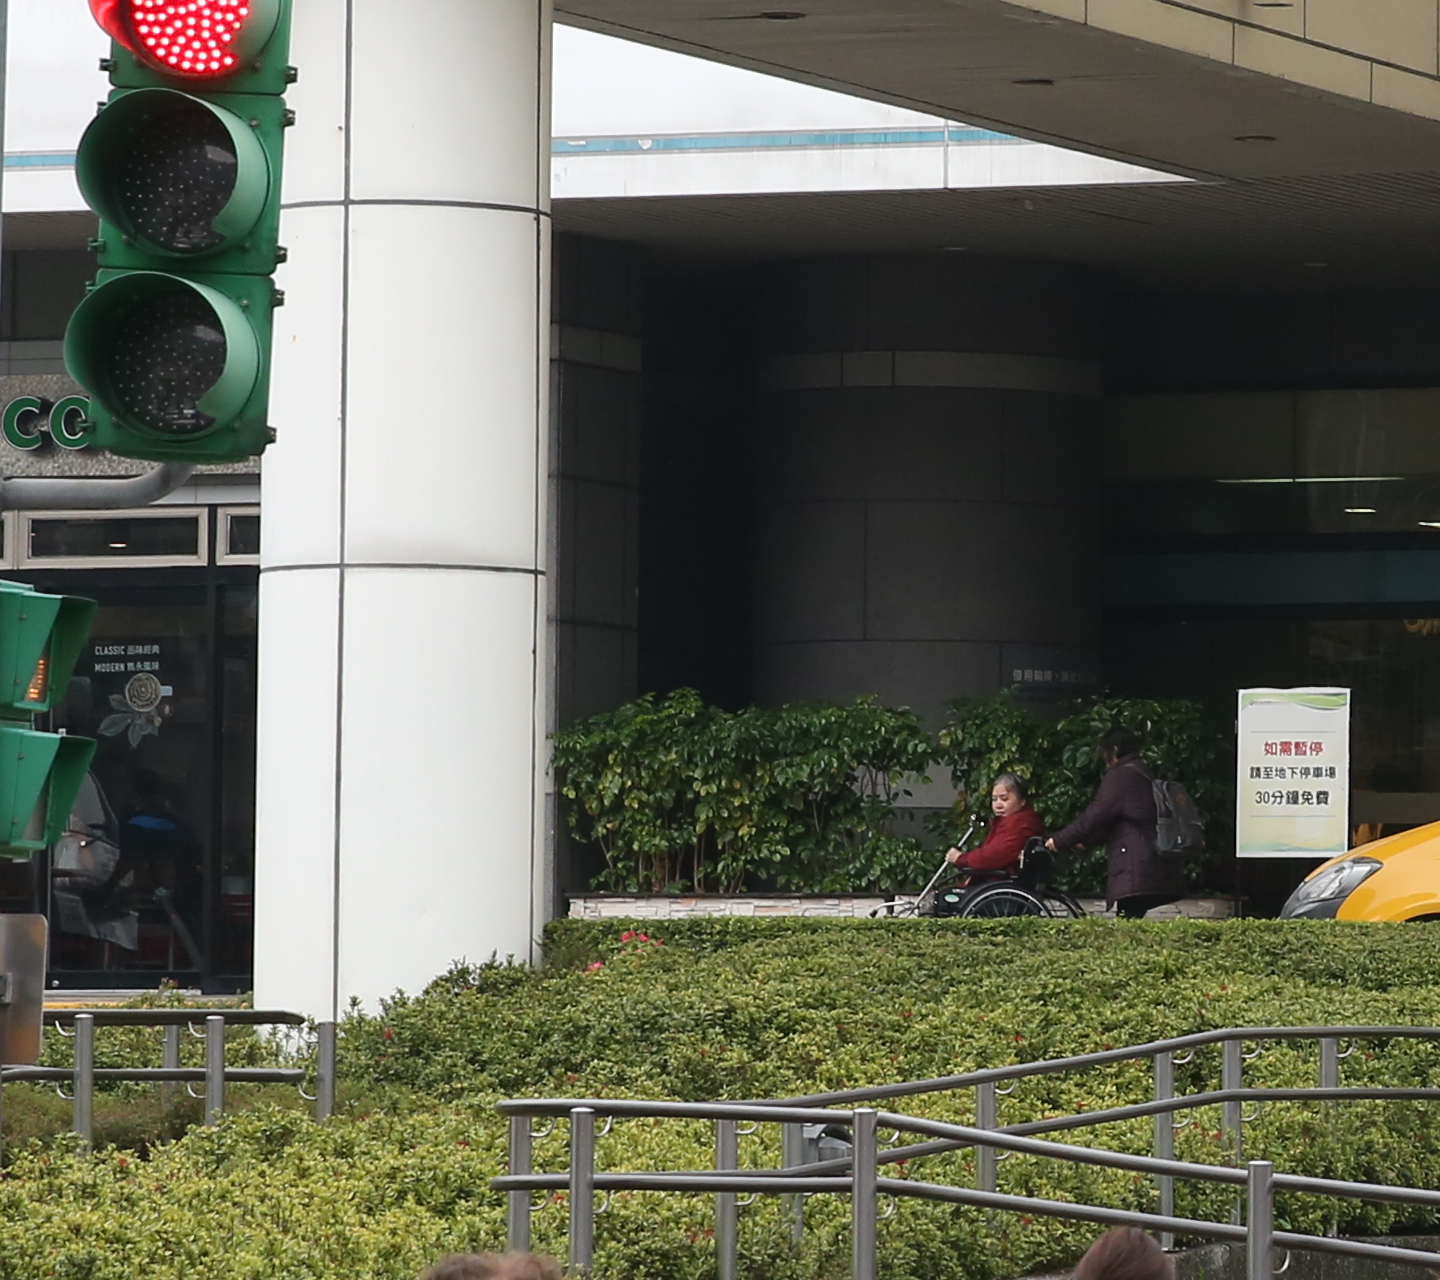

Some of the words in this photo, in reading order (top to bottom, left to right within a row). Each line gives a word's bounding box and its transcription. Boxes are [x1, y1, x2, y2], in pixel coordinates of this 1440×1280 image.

[94, 645, 125, 656] CLASSIC
[94, 662, 125, 672] MODERN
[1264, 741, 1324, 756] 如需暫停
[1254, 790, 1330, 806] 30分鐘免費
